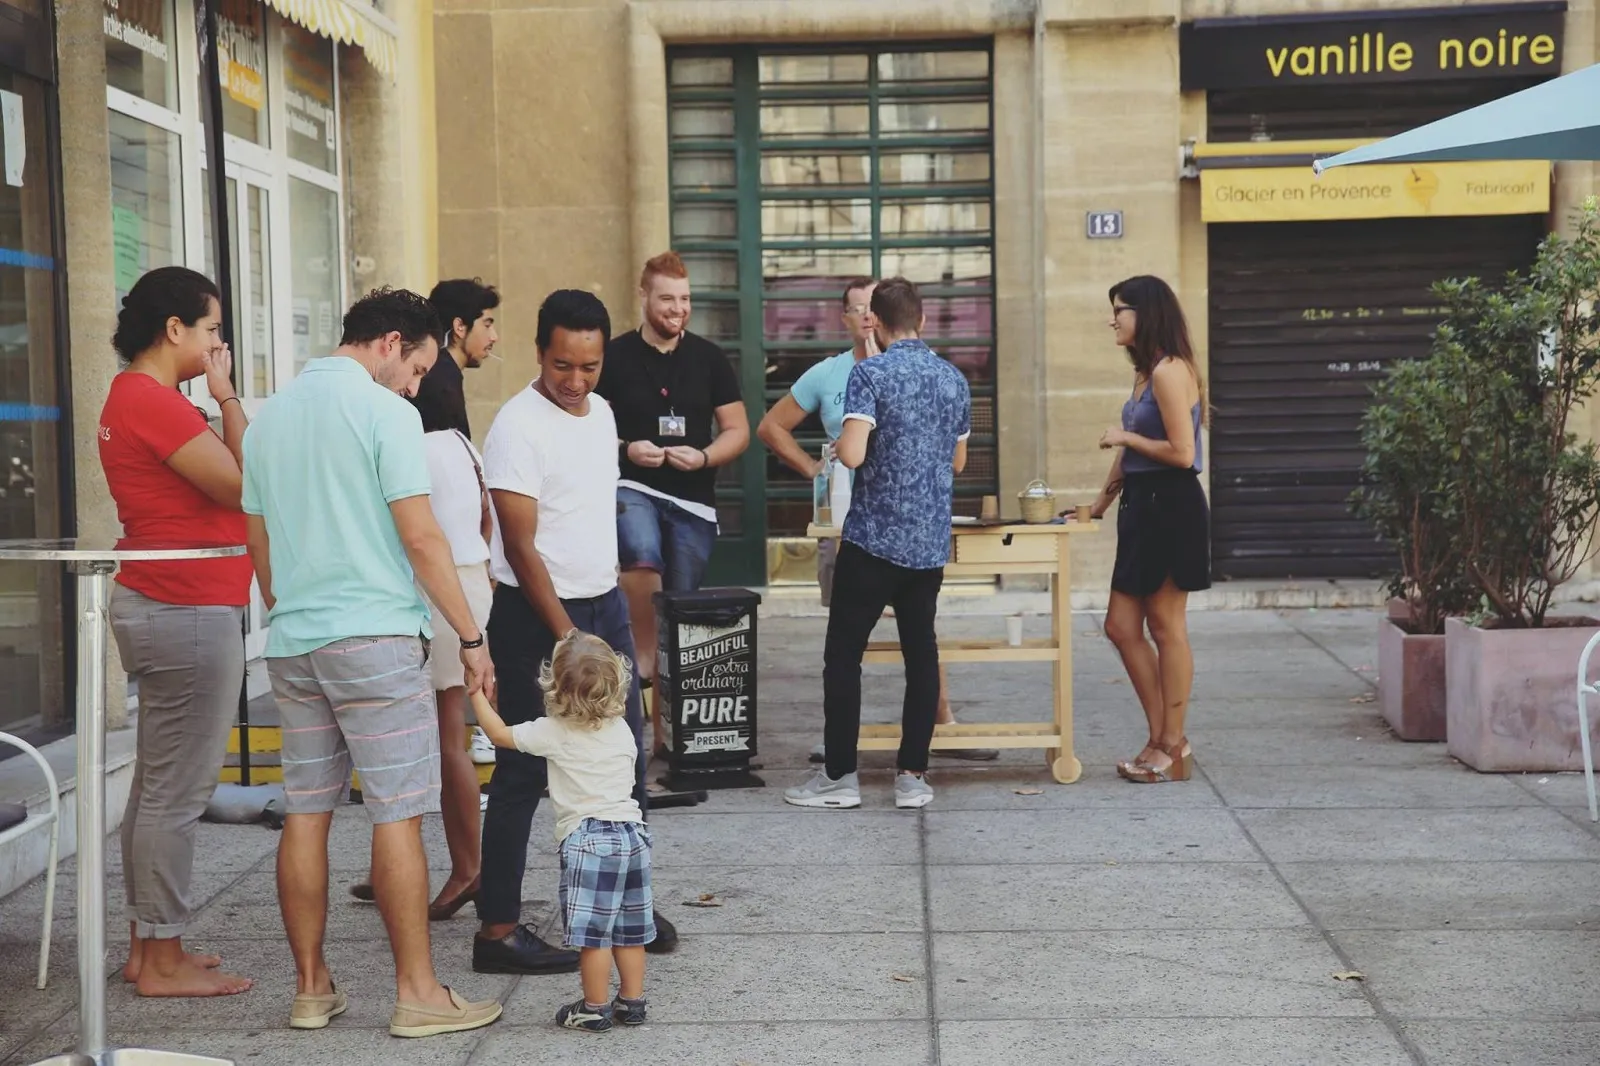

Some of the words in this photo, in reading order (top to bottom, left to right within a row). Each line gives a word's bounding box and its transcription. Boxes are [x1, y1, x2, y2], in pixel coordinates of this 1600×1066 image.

[1266, 32, 1413, 77] vanille
[1439, 28, 1556, 69] noire
[1215, 185, 1276, 203] Glacier
[1282, 187, 1305, 200] en
[1310, 184, 1392, 200] Provence
[1466, 181, 1535, 196] Fabricant
[1095, 214, 1116, 234] 13
[680, 635, 748, 665] BEAUTIFUL
[712, 657, 749, 676] extra
[681, 666, 747, 695] ordinary
[681, 696, 749, 725] PURE
[696, 734, 736, 746] PRESENT
